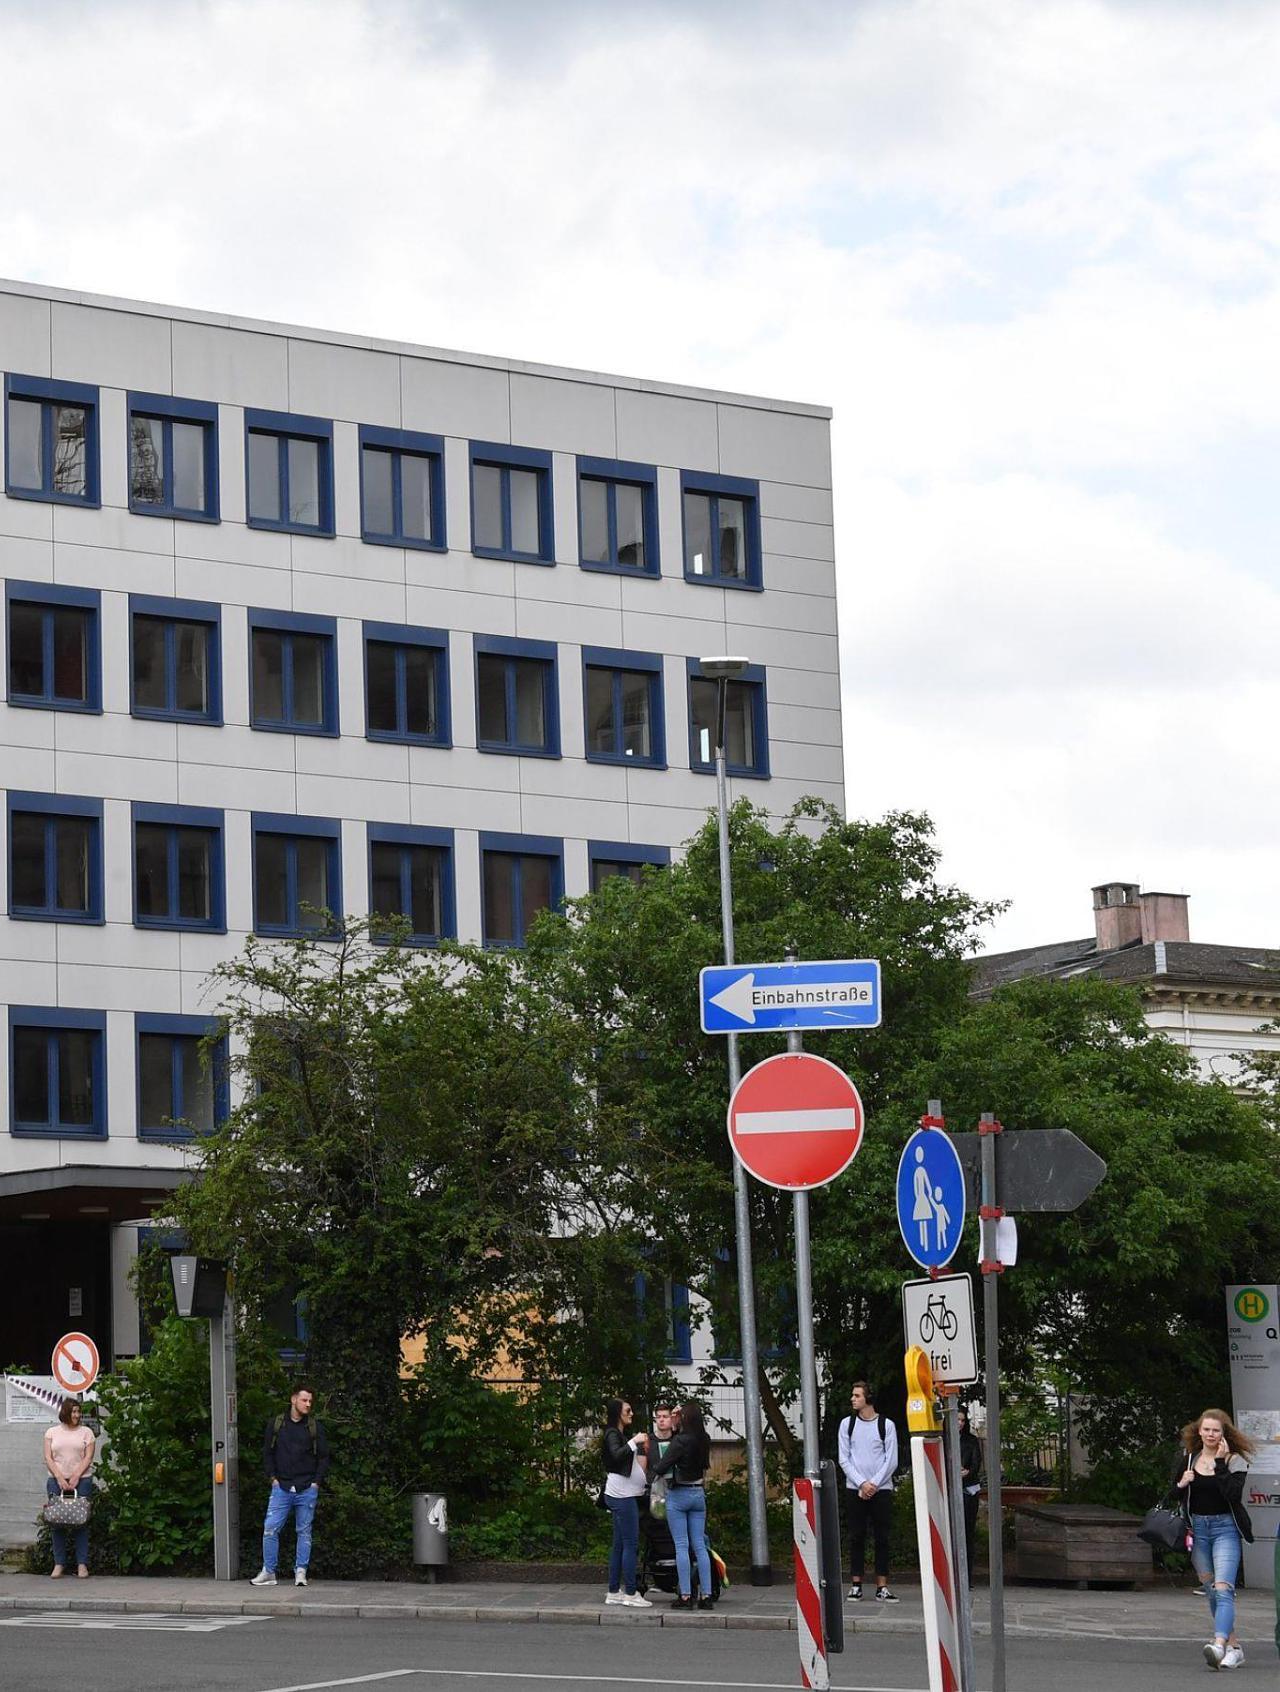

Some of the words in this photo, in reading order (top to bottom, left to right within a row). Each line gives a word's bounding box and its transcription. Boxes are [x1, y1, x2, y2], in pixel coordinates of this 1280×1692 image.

[752, 987, 868, 1005] Einbahnstraße
[1244, 1295, 1258, 1315] H
[1266, 1327, 1278, 1339] Q
[931, 1350, 951, 1371] frei
[215, 1441, 224, 1453] P
